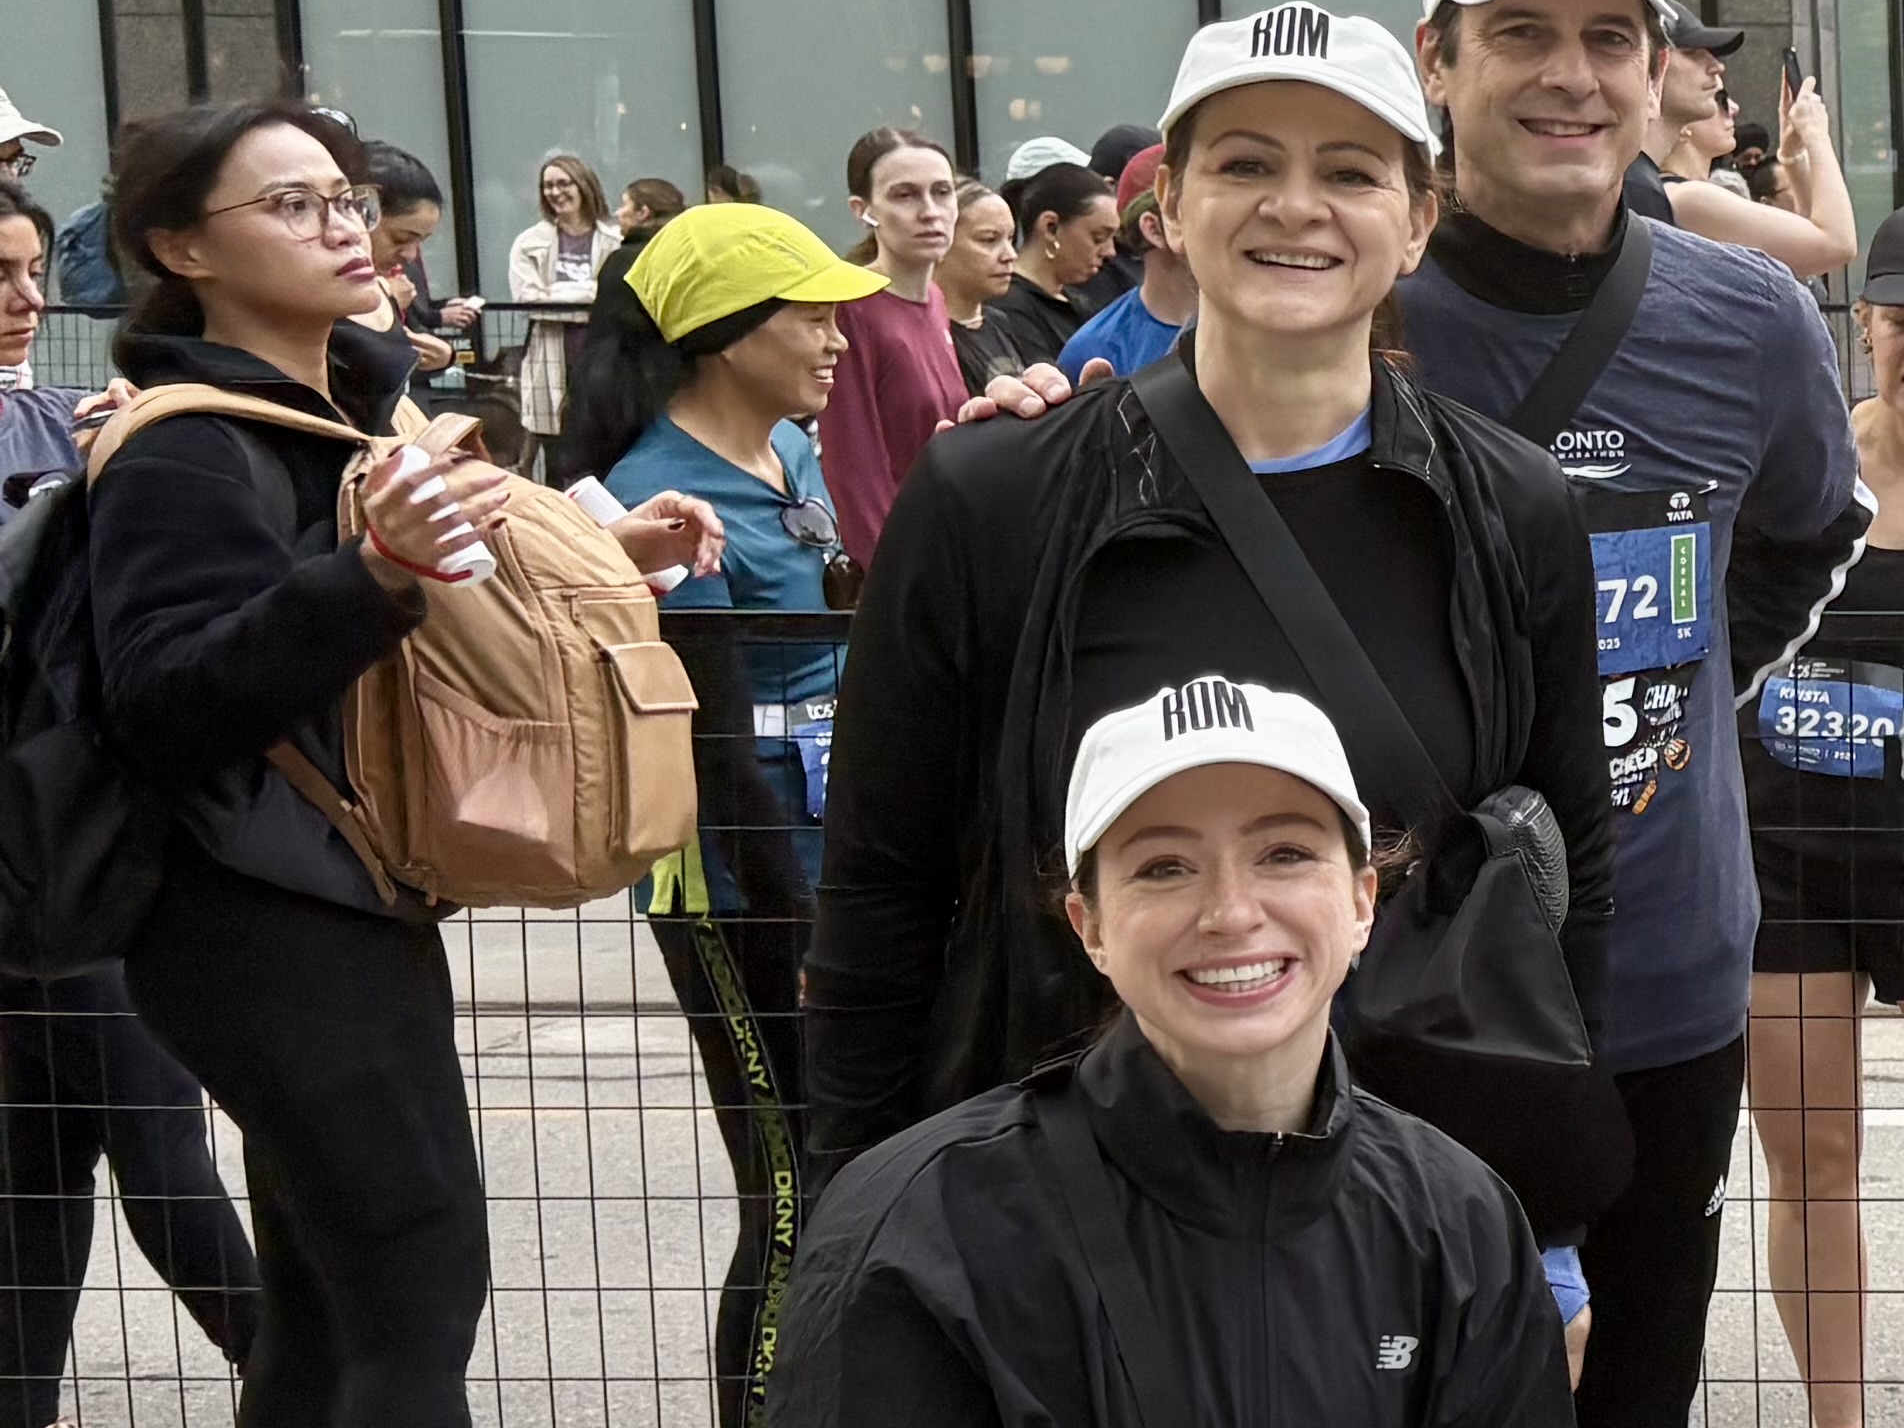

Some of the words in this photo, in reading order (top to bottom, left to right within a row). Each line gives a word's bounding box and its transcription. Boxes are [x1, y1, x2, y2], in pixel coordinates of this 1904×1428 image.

[1250, 6, 1330, 60] ROM
[1551, 429, 1625, 451] ONTO
[1666, 509, 1694, 522] TATA
[1162, 680, 1255, 742] ROM
[1775, 705, 1895, 748] 32320
[773, 1170, 794, 1248] DKNY
